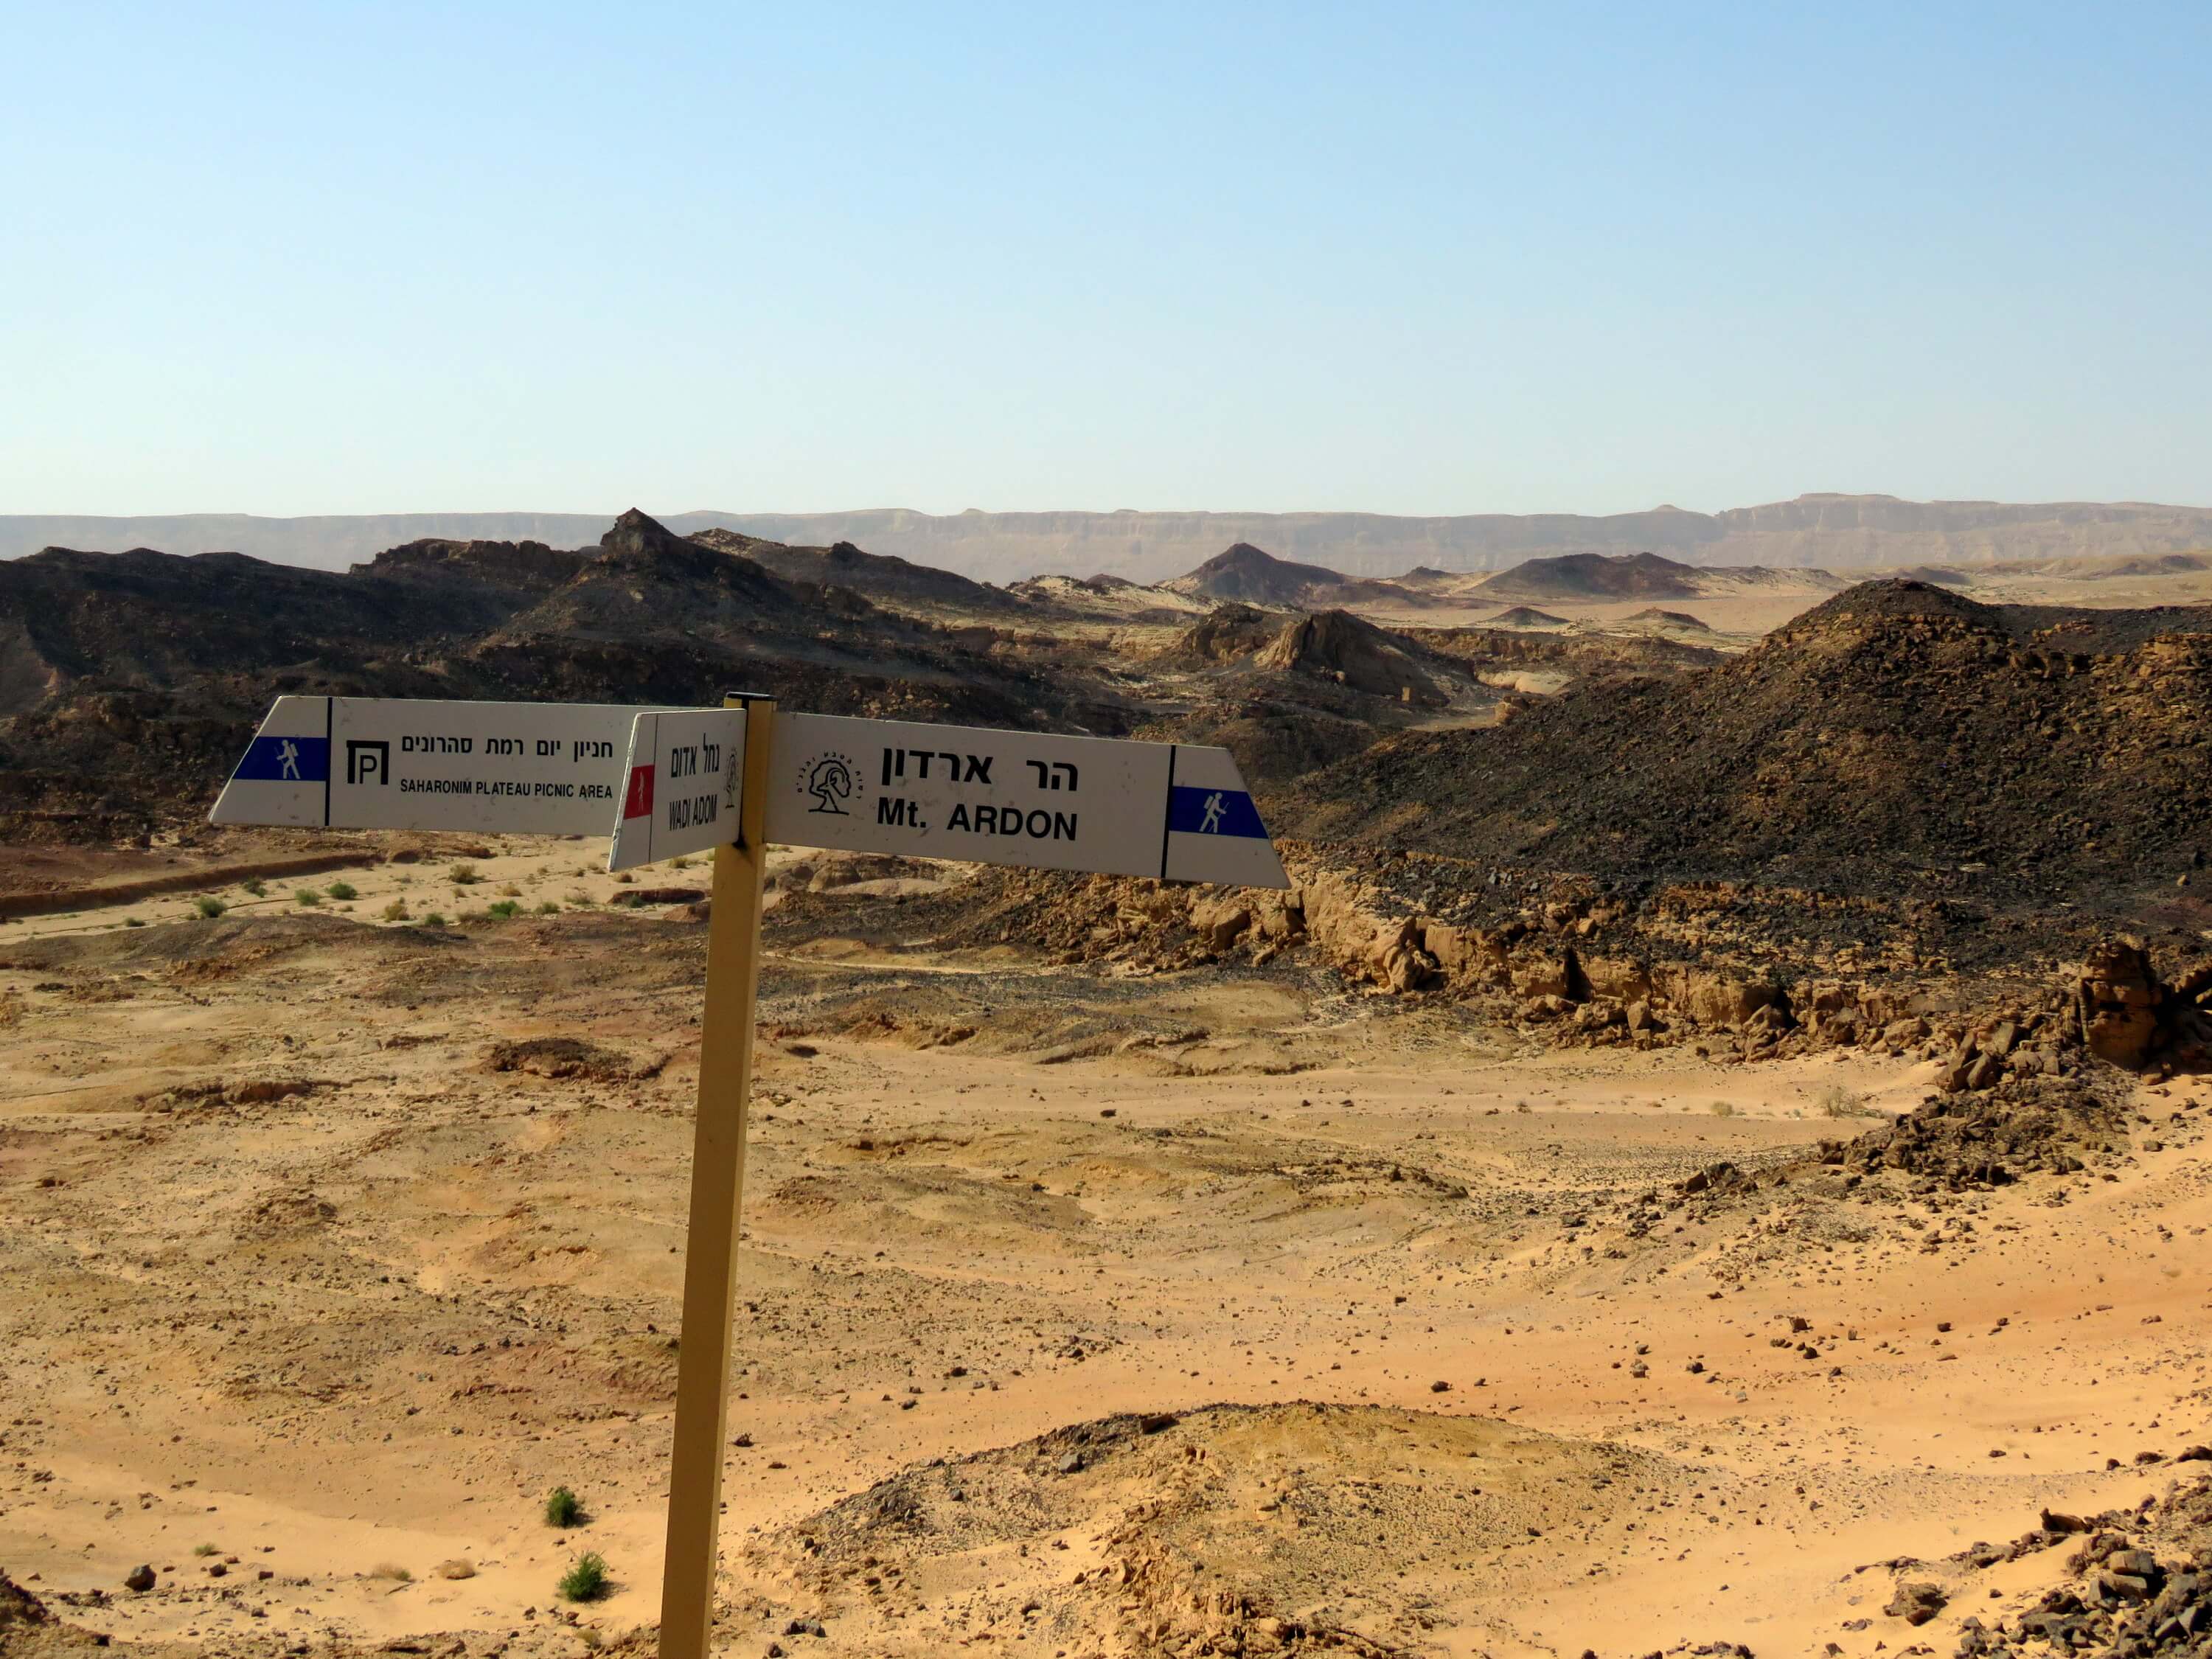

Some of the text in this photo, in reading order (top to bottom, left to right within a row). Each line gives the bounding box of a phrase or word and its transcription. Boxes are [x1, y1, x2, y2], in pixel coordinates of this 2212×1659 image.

[401, 735, 613, 762] חניון יום רמת סהרונים
[670, 745, 698, 779] אדום
[703, 732, 720, 773] נחל
[880, 747, 1079, 792] הר ארדון
[400, 779, 613, 799] SAHARONIM PLATEAU PICNIC AREA
[669, 794, 717, 832] WADI ADOM
[877, 796, 1078, 842] Mt. ARDON
